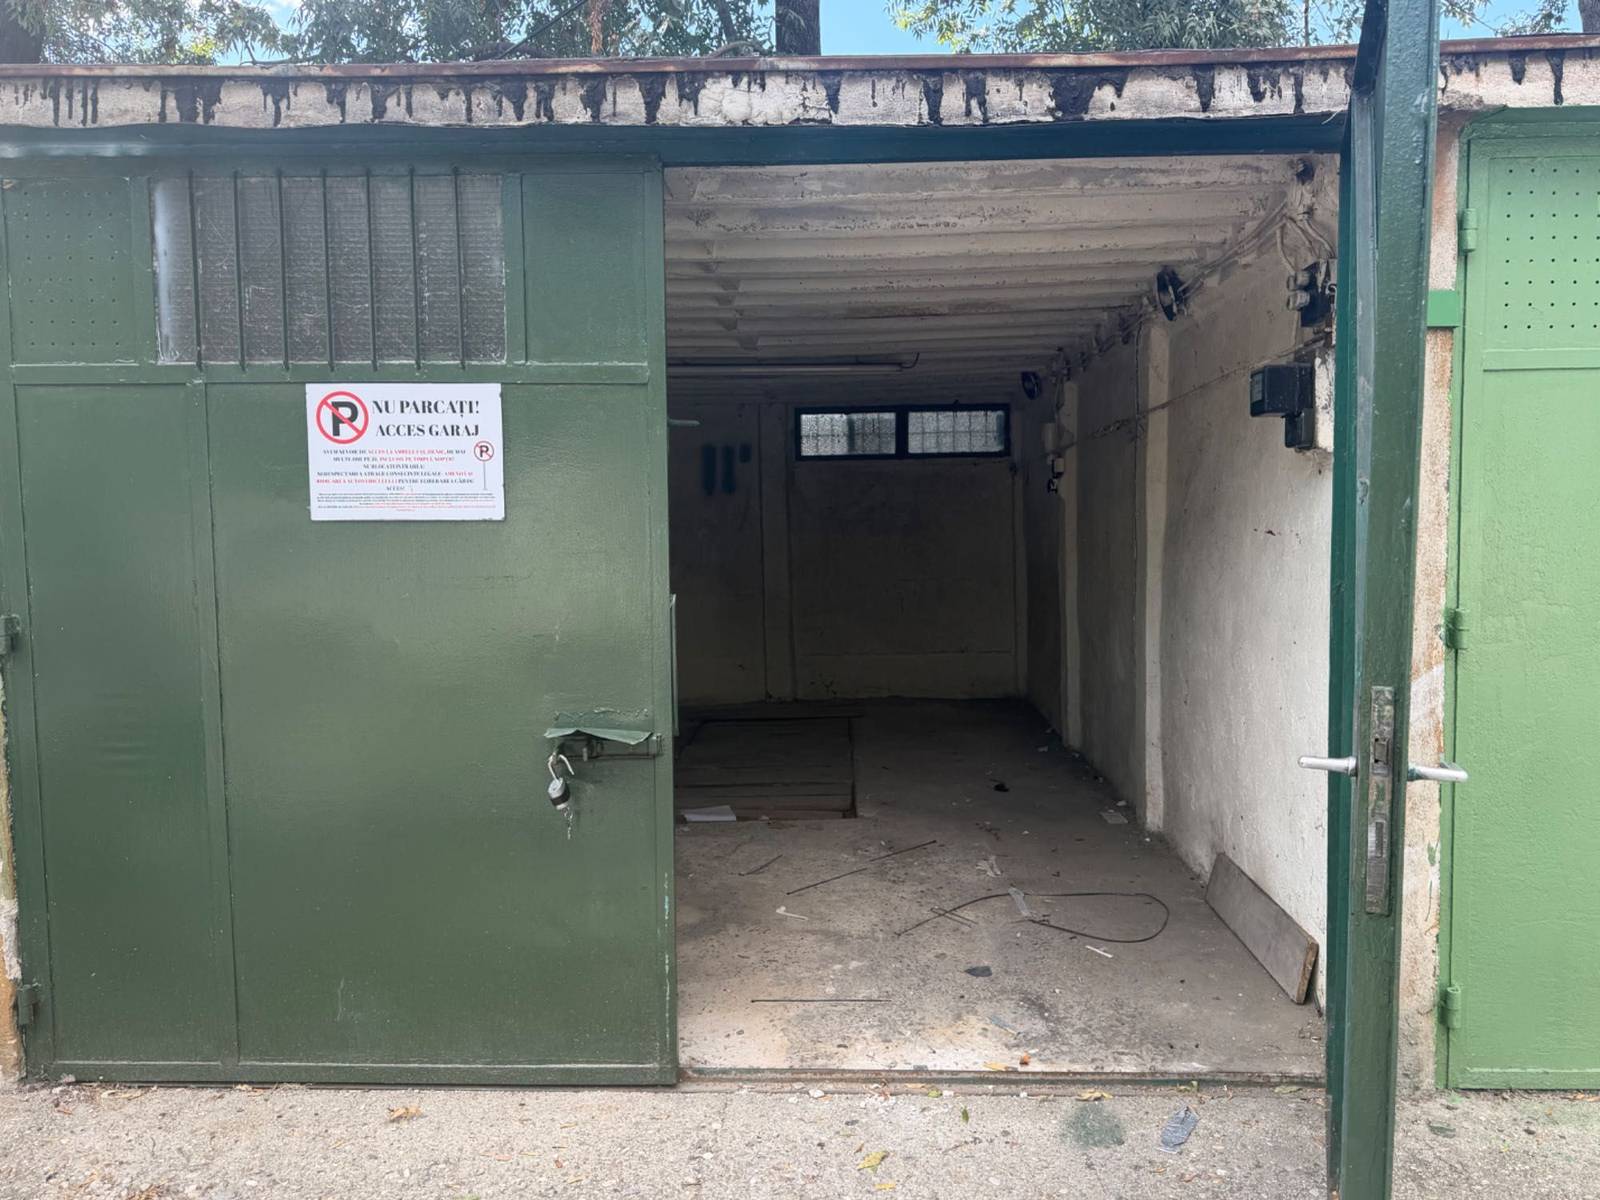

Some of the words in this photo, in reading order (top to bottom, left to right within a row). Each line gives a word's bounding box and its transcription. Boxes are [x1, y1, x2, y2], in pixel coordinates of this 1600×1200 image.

[372, 400, 396, 414] NU
[399, 400, 480, 417] PARCAȚI!
[375, 424, 426, 437] ACCES
[429, 424, 480, 437] GARAJ
